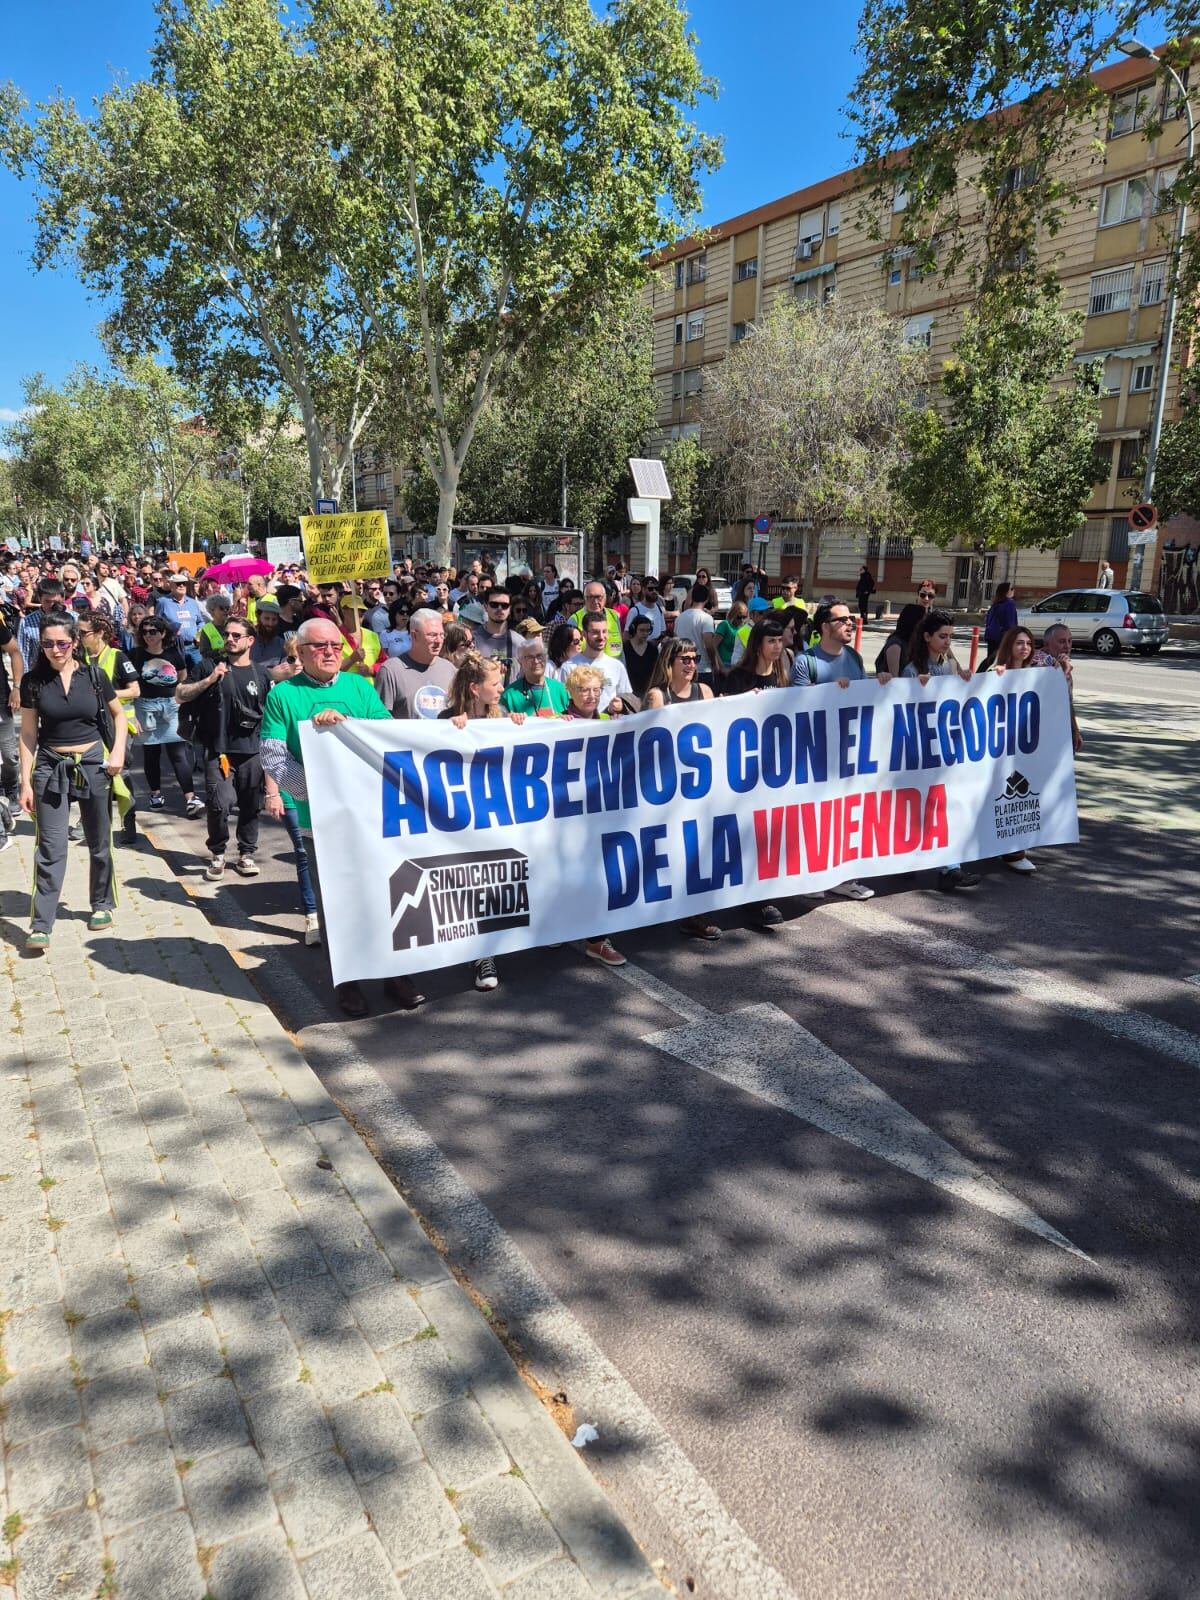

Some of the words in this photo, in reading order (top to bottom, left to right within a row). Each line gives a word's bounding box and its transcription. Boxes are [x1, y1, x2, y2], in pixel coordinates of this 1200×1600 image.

[382, 723, 712, 838] ACABEMOS
[726, 710, 828, 794] CON
[839, 705, 879, 779] EL
[889, 690, 1041, 772] NEGOCIO
[994, 799, 1040, 816] PLATAFORMA
[995, 817, 1004, 829] DE
[1005, 811, 1040, 826] AFECTADOS
[996, 829, 1009, 840] POR
[1008, 828, 1016, 837] LA
[1016, 822, 1041, 835] HIPOTECA
[601, 823, 673, 911] DE
[682, 812, 744, 896] LA
[753, 783, 949, 881] VIVIENDA
[429, 861, 507, 892] SINDICATO
[510, 859, 530, 882] DE
[431, 881, 530, 926] VIVIENDA
[437, 922, 476, 944] MURCIA
